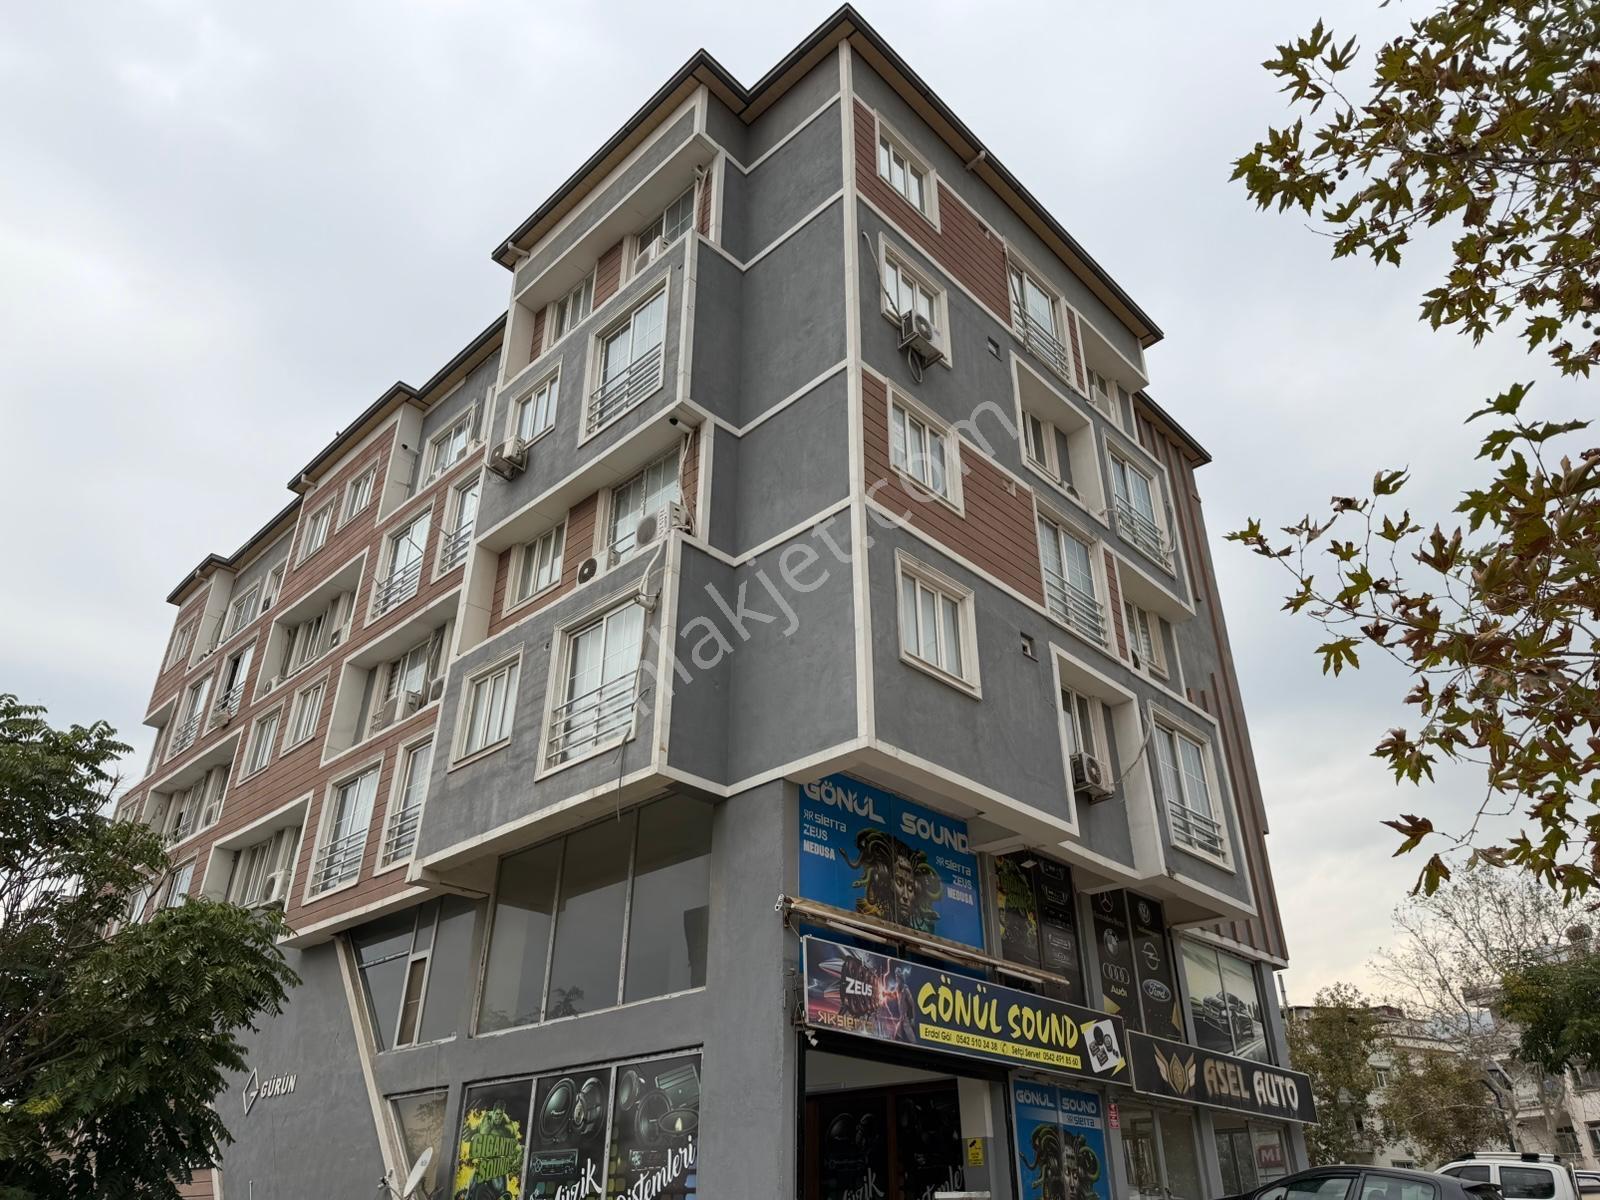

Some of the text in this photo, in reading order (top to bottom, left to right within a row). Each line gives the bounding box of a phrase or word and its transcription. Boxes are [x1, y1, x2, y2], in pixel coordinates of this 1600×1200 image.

[803, 823, 828, 841] ZEUS
[900, 812, 976, 855] SOUND
[803, 839, 836, 862] MEDUSA
[952, 874, 972, 890] ZEUS
[845, 976, 873, 997] ZEUS
[917, 974, 1079, 1049] GÖNÜL SOUND
[956, 1034, 970, 1046] 0542
[971, 1037, 981, 1048] 510
[983, 1040, 990, 1049] 34
[1042, 1051, 1055, 1062] 0542
[1203, 1058, 1299, 1112] ASEL AUTO
[1016, 1089, 1097, 1114] GÖNÜL SOUND
[548, 1158, 602, 1200] üzik
[616, 1134, 697, 1200] istemleri
